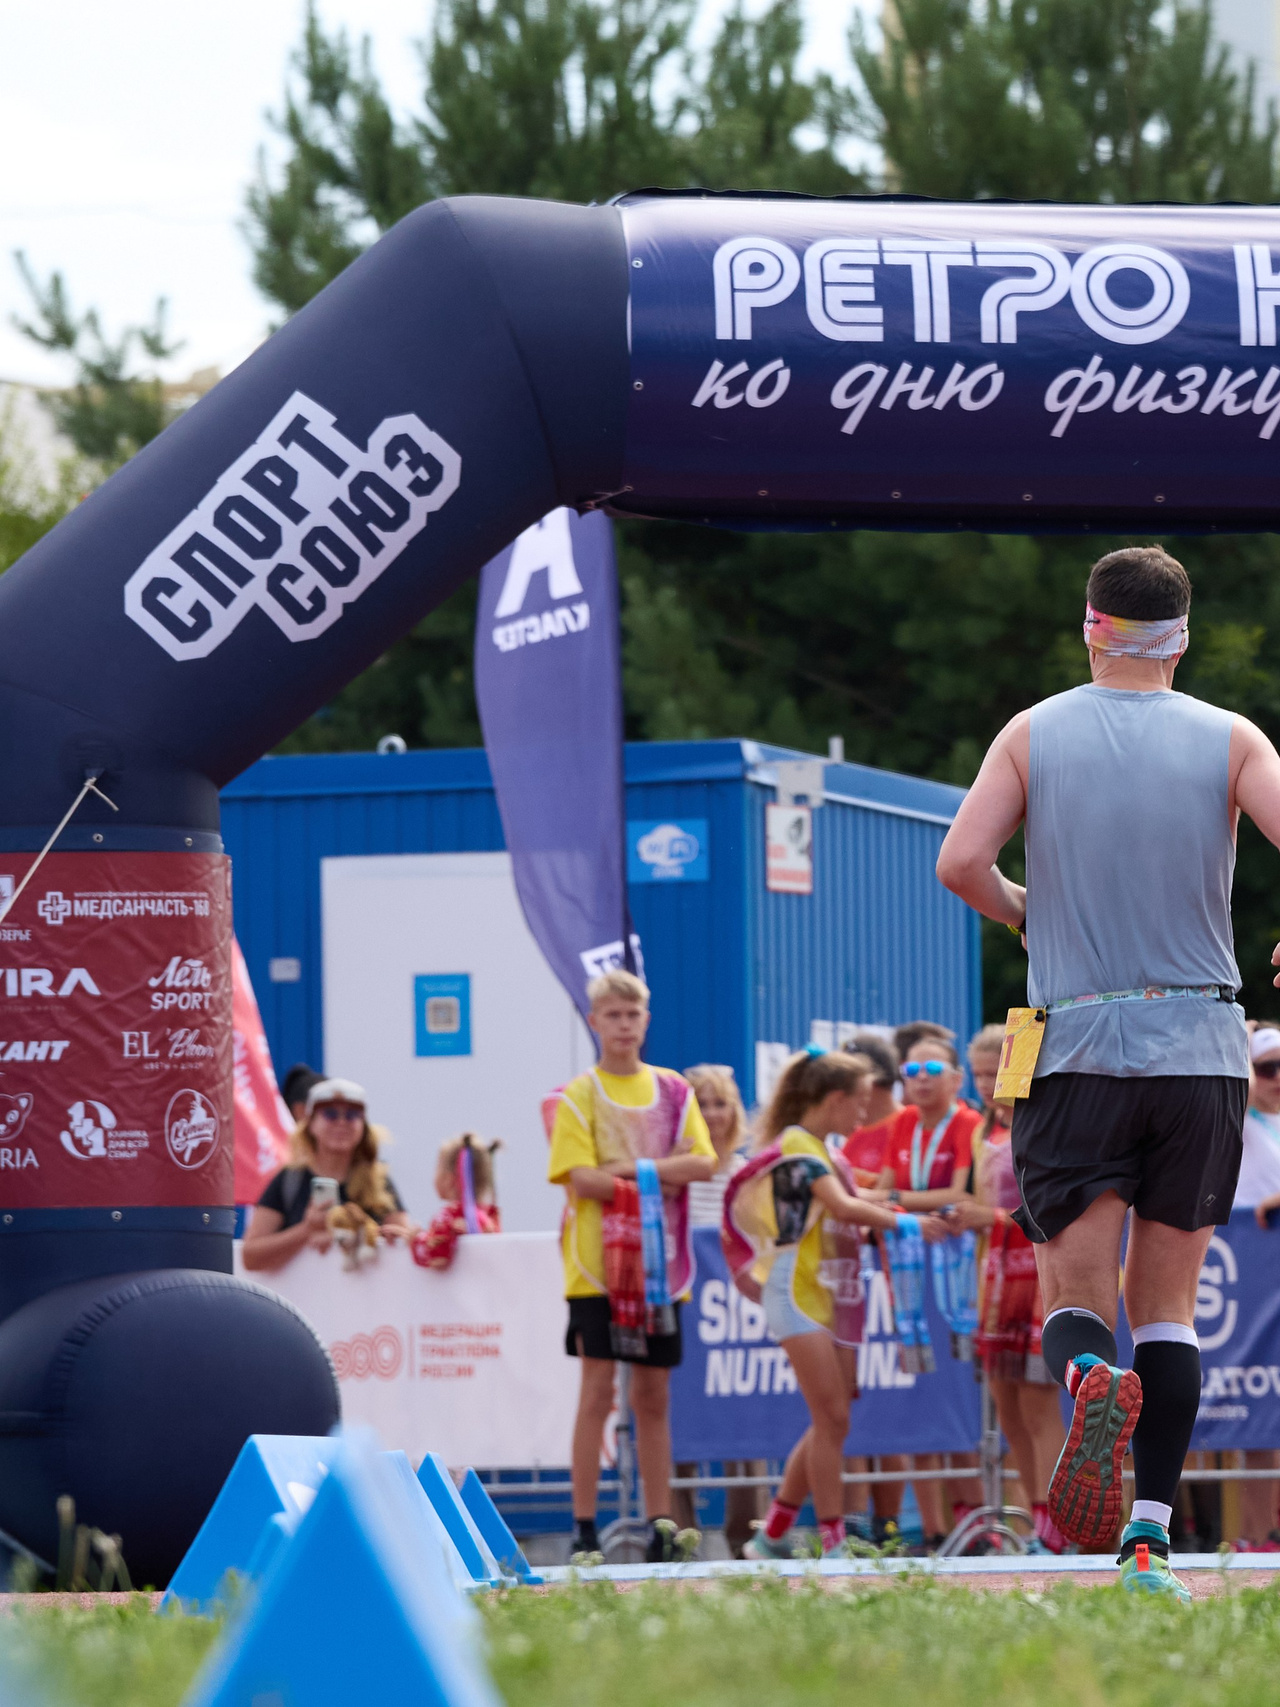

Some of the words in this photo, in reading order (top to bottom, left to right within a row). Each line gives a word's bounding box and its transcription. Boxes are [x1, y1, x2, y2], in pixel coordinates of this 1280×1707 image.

[713, 236, 1191, 345] РЕТРО
[691, 356, 791, 409] ко
[830, 359, 1005, 435] дню
[141, 412, 350, 644] СПОРТ
[266, 433, 445, 626] СОЮЗ
[0, 929, 31, 941] ЗЕРЬЕ
[150, 992, 212, 1010] SPORT
[121, 1031, 160, 1058] EL
